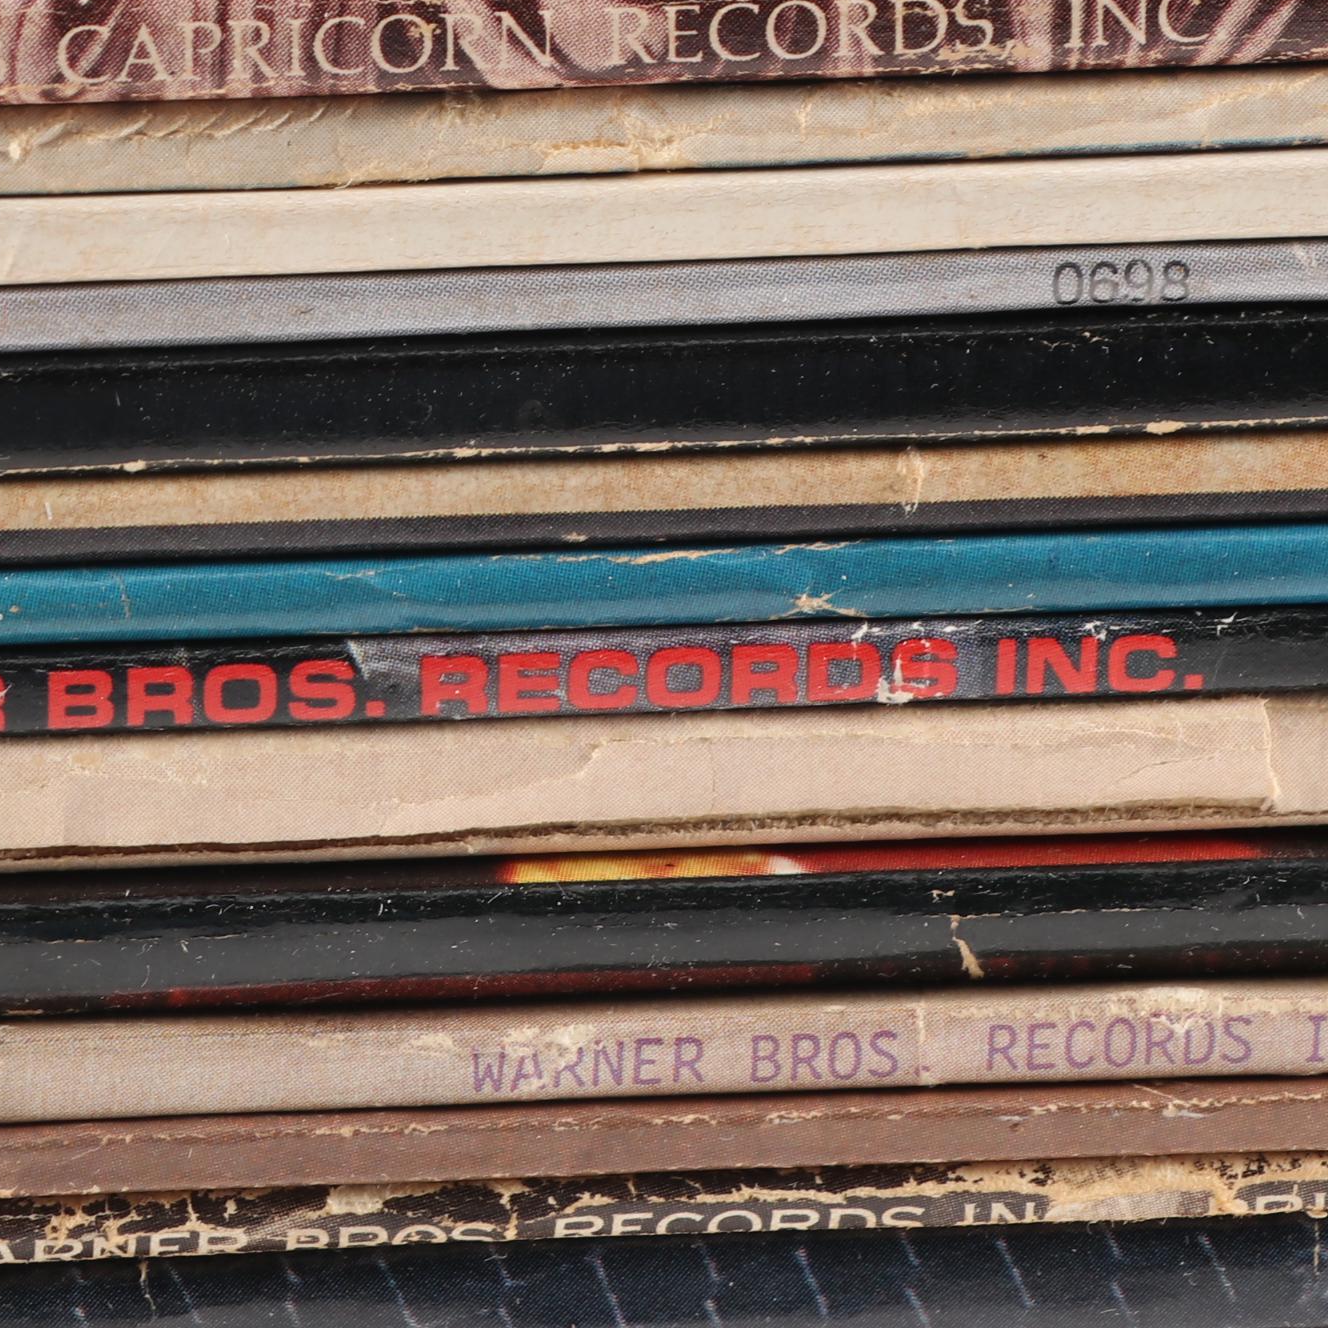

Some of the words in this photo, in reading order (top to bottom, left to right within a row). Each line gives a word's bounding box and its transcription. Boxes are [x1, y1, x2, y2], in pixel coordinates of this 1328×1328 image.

[56, 8, 554, 86] CAPRICORN
[1052, 258, 1193, 306] 0698
[46, 657, 385, 730] BROS.
[419, 635, 961, 716] RECORDS
[995, 633, 1205, 695] INC.
[472, 1033, 706, 1094] WARNER
[985, 1013, 1254, 1073] RECORDS
